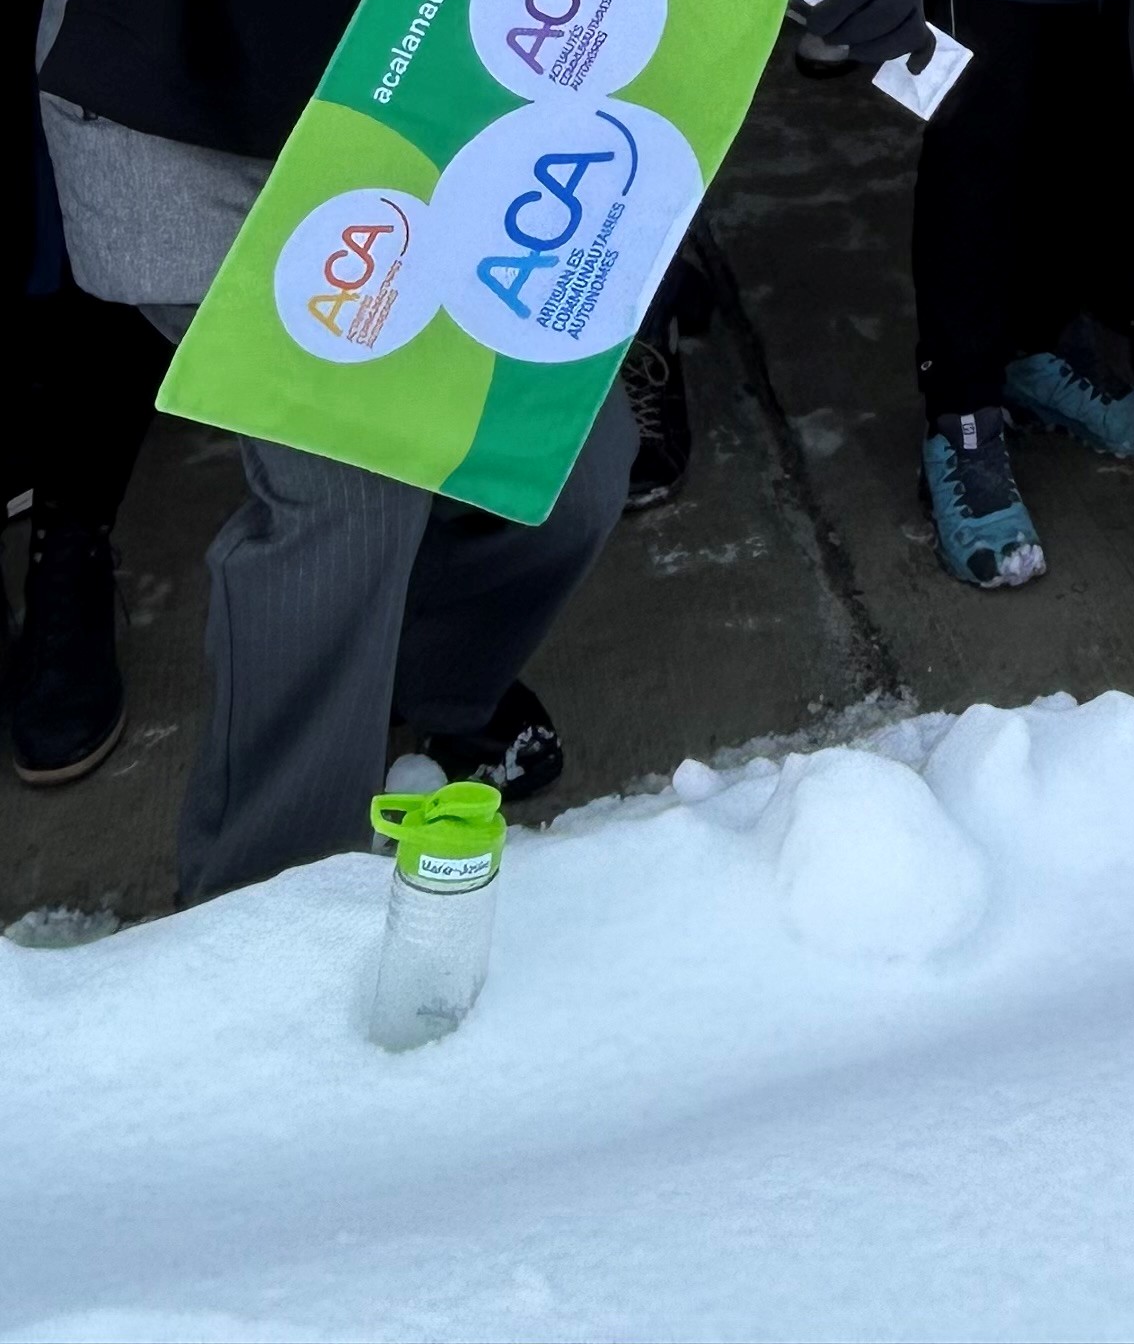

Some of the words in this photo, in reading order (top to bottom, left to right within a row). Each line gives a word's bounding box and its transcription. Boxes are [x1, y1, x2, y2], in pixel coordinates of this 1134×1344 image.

[307, 224, 395, 338] ACA
[476, 151, 616, 320] ACA
[551, 201, 626, 333] COMMUNAUTAIRES
[567, 248, 619, 341] AUTONOMES
